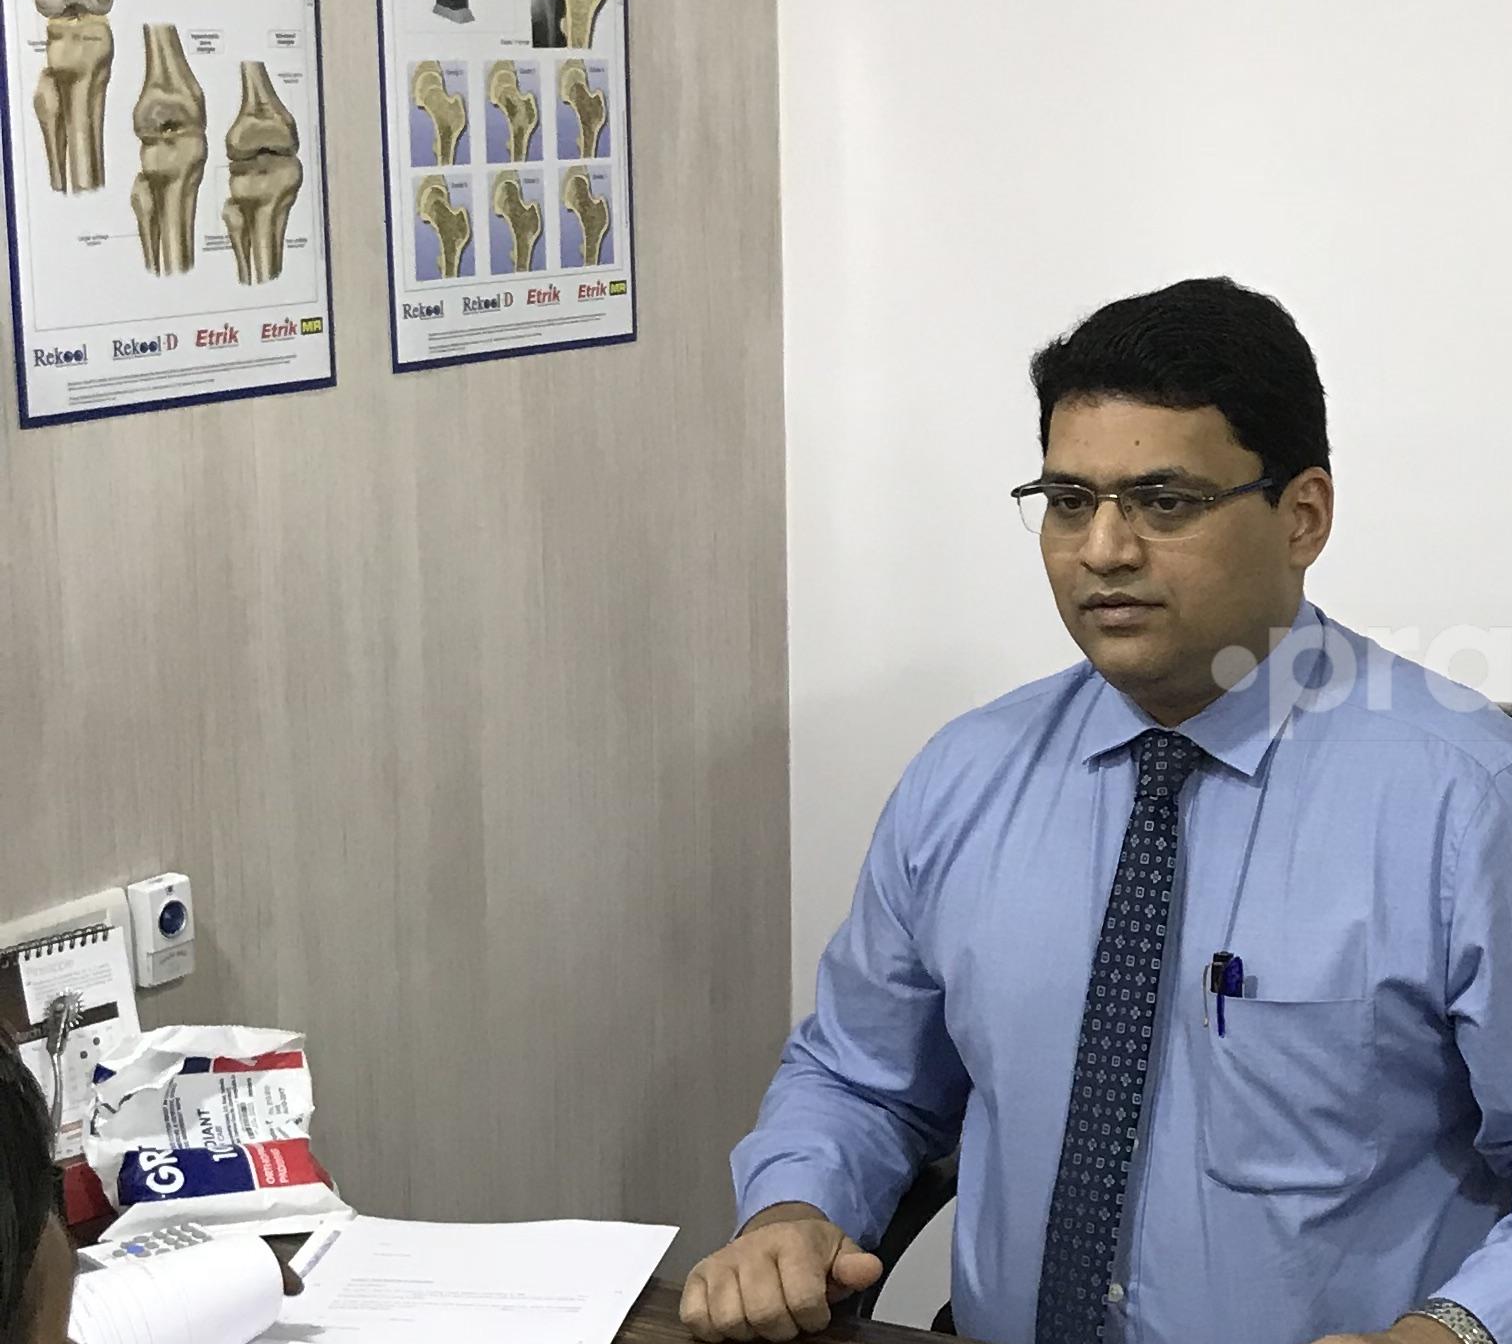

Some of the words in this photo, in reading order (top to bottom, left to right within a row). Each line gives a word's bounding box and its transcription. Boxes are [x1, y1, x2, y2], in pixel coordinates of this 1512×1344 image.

[403, 301, 444, 320] Rekool
[526, 284, 561, 305] Etrik
[577, 280, 607, 301] Etrik
[33, 344, 88, 367] Rekool
[195, 322, 239, 347] Etrik
[261, 317, 298, 340] Etrik
